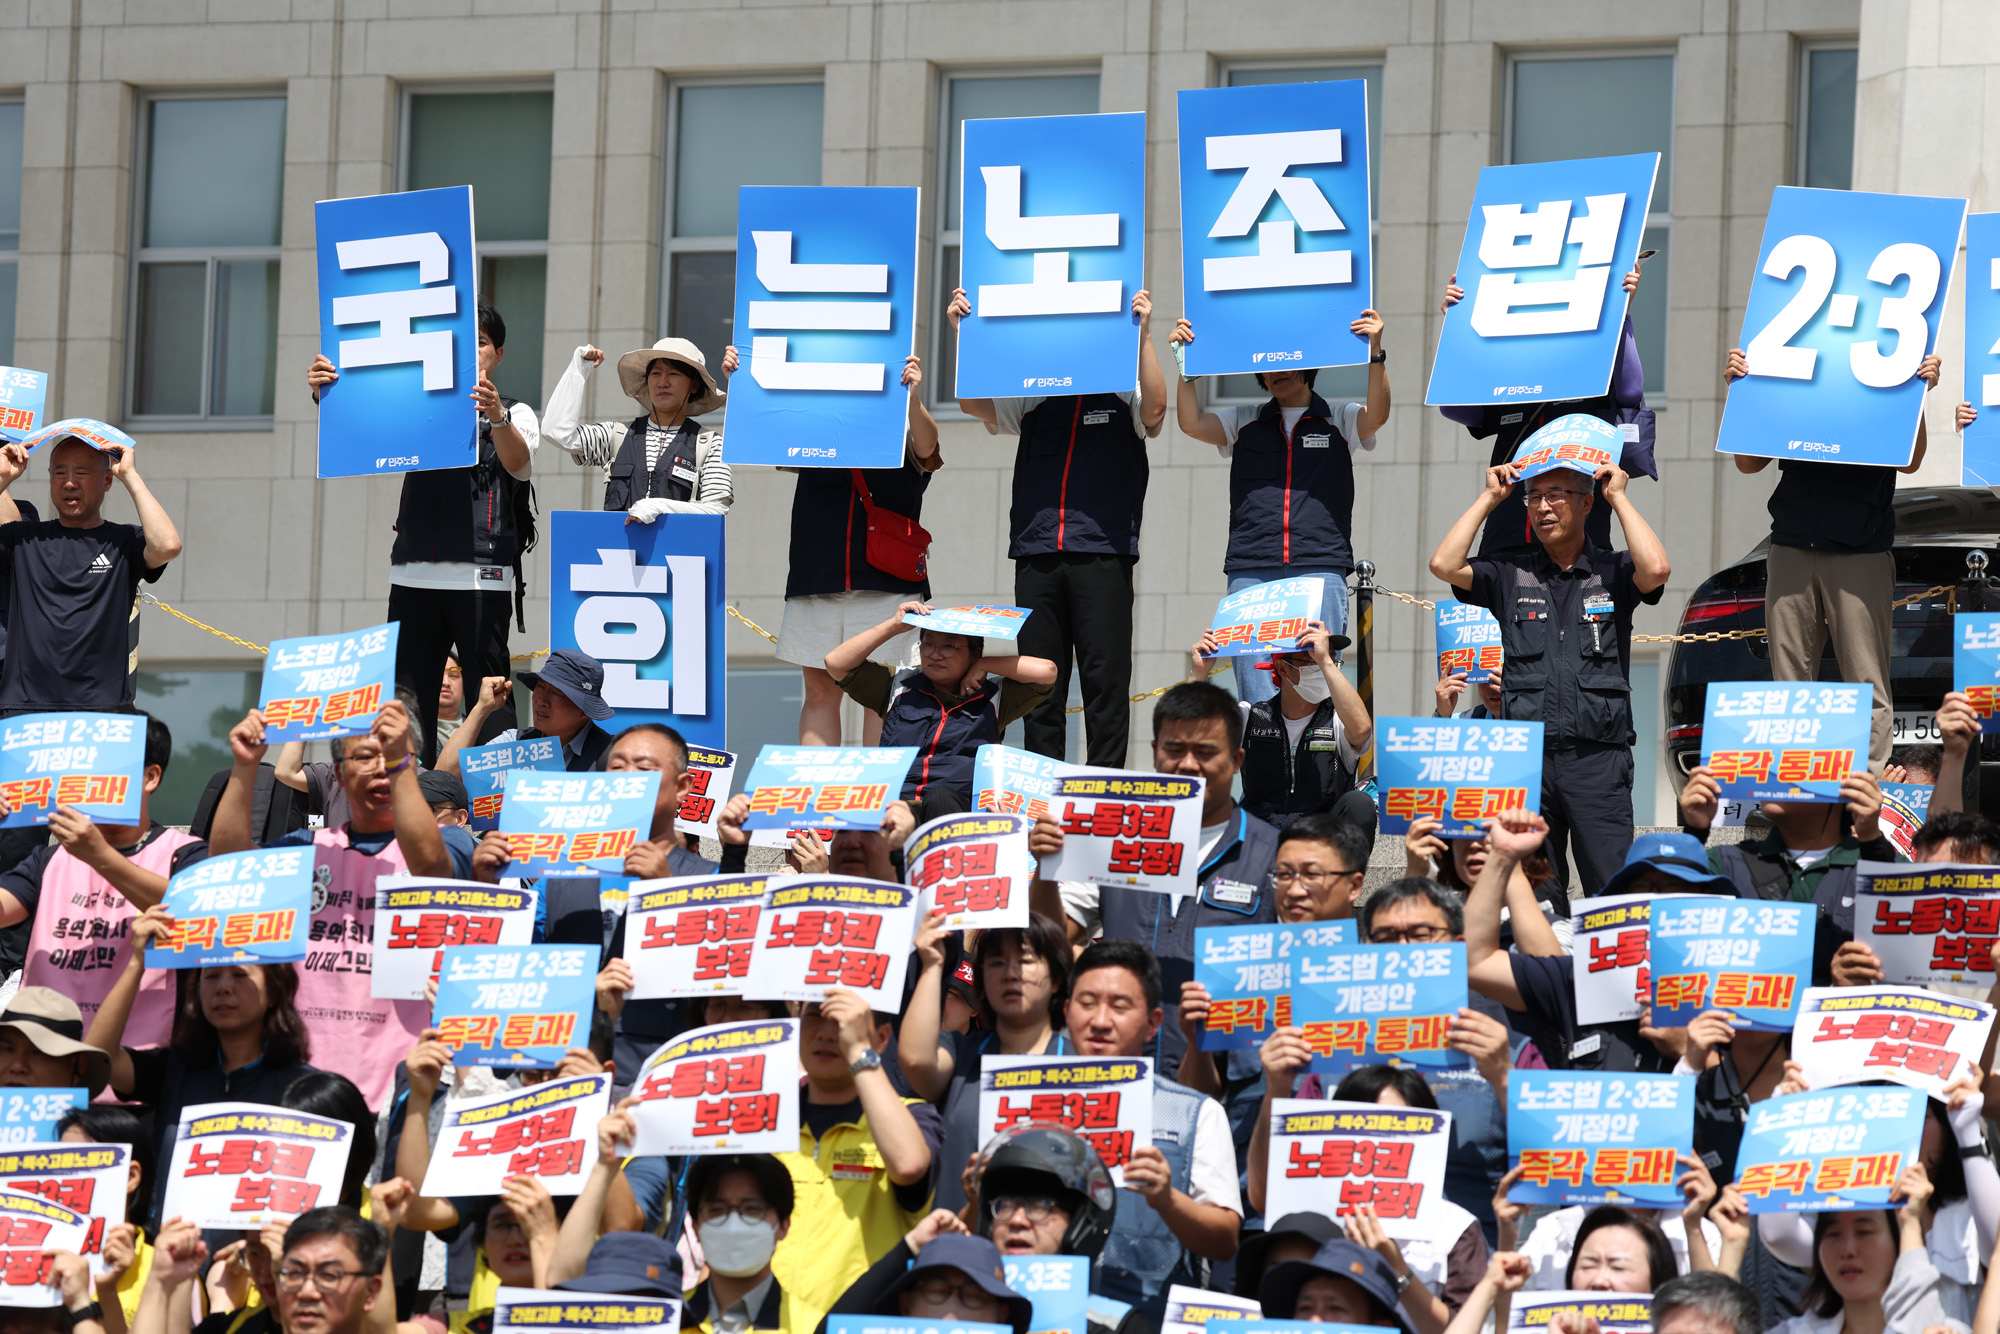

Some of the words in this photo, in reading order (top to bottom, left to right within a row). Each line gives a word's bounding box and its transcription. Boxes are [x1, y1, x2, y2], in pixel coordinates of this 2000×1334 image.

[1203, 128, 1351, 291] 조
[977, 165, 1122, 317] 노
[1470, 192, 1626, 338] 법
[333, 231, 456, 391] 국
[748, 230, 891, 391] 는
[1267, 350, 1302, 362] 민주노총
[0, 371, 38, 389] ·3조
[1038, 376, 1072, 388] 민주노총
[1508, 385, 1543, 396] 민주노총
[388, 455, 419, 467] 민주노총
[801, 447, 836, 459] 민주노총
[1803, 441, 1841, 454] 민주노총
[1220, 586, 1267, 614] 노조법
[1235, 600, 1288, 621] 개정안
[1439, 604, 1483, 626] 노조법
[1213, 623, 1255, 647] 즉각
[272, 641, 336, 671] 노조법
[296, 663, 359, 692] 개정안
[265, 697, 321, 728] 즉각
[322, 683, 382, 724] 통과!
[1714, 690, 1787, 716] 노조법
[2, 723, 65, 751] 노조법
[1386, 726, 1459, 752] 노조법
[1742, 718, 1821, 744] 개정안
[25, 746, 97, 773] 개정안
[466, 747, 513, 773] 노조법
[764, 749, 832, 766] 노조법
[788, 764, 864, 782] 개정안
[1417, 757, 1494, 782] 개정안
[1707, 749, 1774, 783] 즉각
[1777, 748, 1855, 784] 통과!
[1, 780, 51, 812] 즉각
[55, 774, 130, 805] 통과!
[512, 776, 580, 802] 노조법
[750, 787, 813, 815] 즉각
[815, 785, 887, 812] 통과!
[1063, 780, 1191, 796] 간접고용·특수고용노동자
[1387, 787, 1445, 820] 즉각
[1449, 786, 1527, 821] 통과!
[539, 804, 612, 829] 개정안
[676, 795, 716, 824] 장!
[1060, 802, 1174, 839] 노동3권
[506, 834, 567, 865] 즉각
[567, 830, 635, 862] 통과!
[1108, 839, 1184, 876] 보장!
[170, 860, 237, 896] 노조법
[186, 883, 264, 911] 개정안
[933, 876, 1010, 916] 보장!
[152, 916, 219, 953] 즉각
[223, 909, 296, 948] 통과!
[388, 913, 503, 949] 노동3권
[640, 905, 761, 949] 노동3권
[765, 910, 884, 949] 노동3권
[1657, 908, 1726, 938] 노조법
[1872, 897, 2000, 935] 노동3권
[1203, 932, 1273, 964] 노조법
[1588, 929, 1650, 973] 노동
[1682, 939, 1760, 967] 개정안
[448, 953, 521, 982] 노조법
[804, 949, 889, 989] 보장!
[1234, 963, 1291, 992] 개정
[1300, 952, 1378, 984] 노조법
[471, 982, 548, 1009] 개정안
[1335, 983, 1416, 1013] 개정안
[1656, 973, 1709, 1010] 즉각
[1712, 972, 1797, 1010] 통과!
[437, 1016, 499, 1051] 즉각
[499, 1012, 577, 1048] 통과!
[1205, 997, 1268, 1034] 즉각
[1812, 1013, 1956, 1048] 노동3권
[1301, 1020, 1369, 1058] 즉각
[640, 1054, 765, 1100] 노동3권
[1863, 1041, 1962, 1081] 보장!
[995, 1091, 1121, 1132] 노동3권
[1518, 1082, 1602, 1110] 노조법
[692, 1093, 779, 1137] 보장!
[1552, 1114, 1639, 1144] 개정안
[1751, 1103, 1832, 1136] 노조법
[451, 1106, 577, 1158] 노동3권
[1779, 1128, 1868, 1157] 개정안
[183, 1139, 315, 1179] 노동3권
[503, 1139, 586, 1184] 보장!
[1085, 1130, 1134, 1168] 장!
[1286, 1140, 1414, 1179] 노동3권
[1518, 1150, 1586, 1186] 즉각
[1593, 1147, 1678, 1185] 통과!
[1736, 1160, 1813, 1199] 즉각
[1815, 1153, 1904, 1194] 통과!
[1337, 1180, 1423, 1219] 보장!
